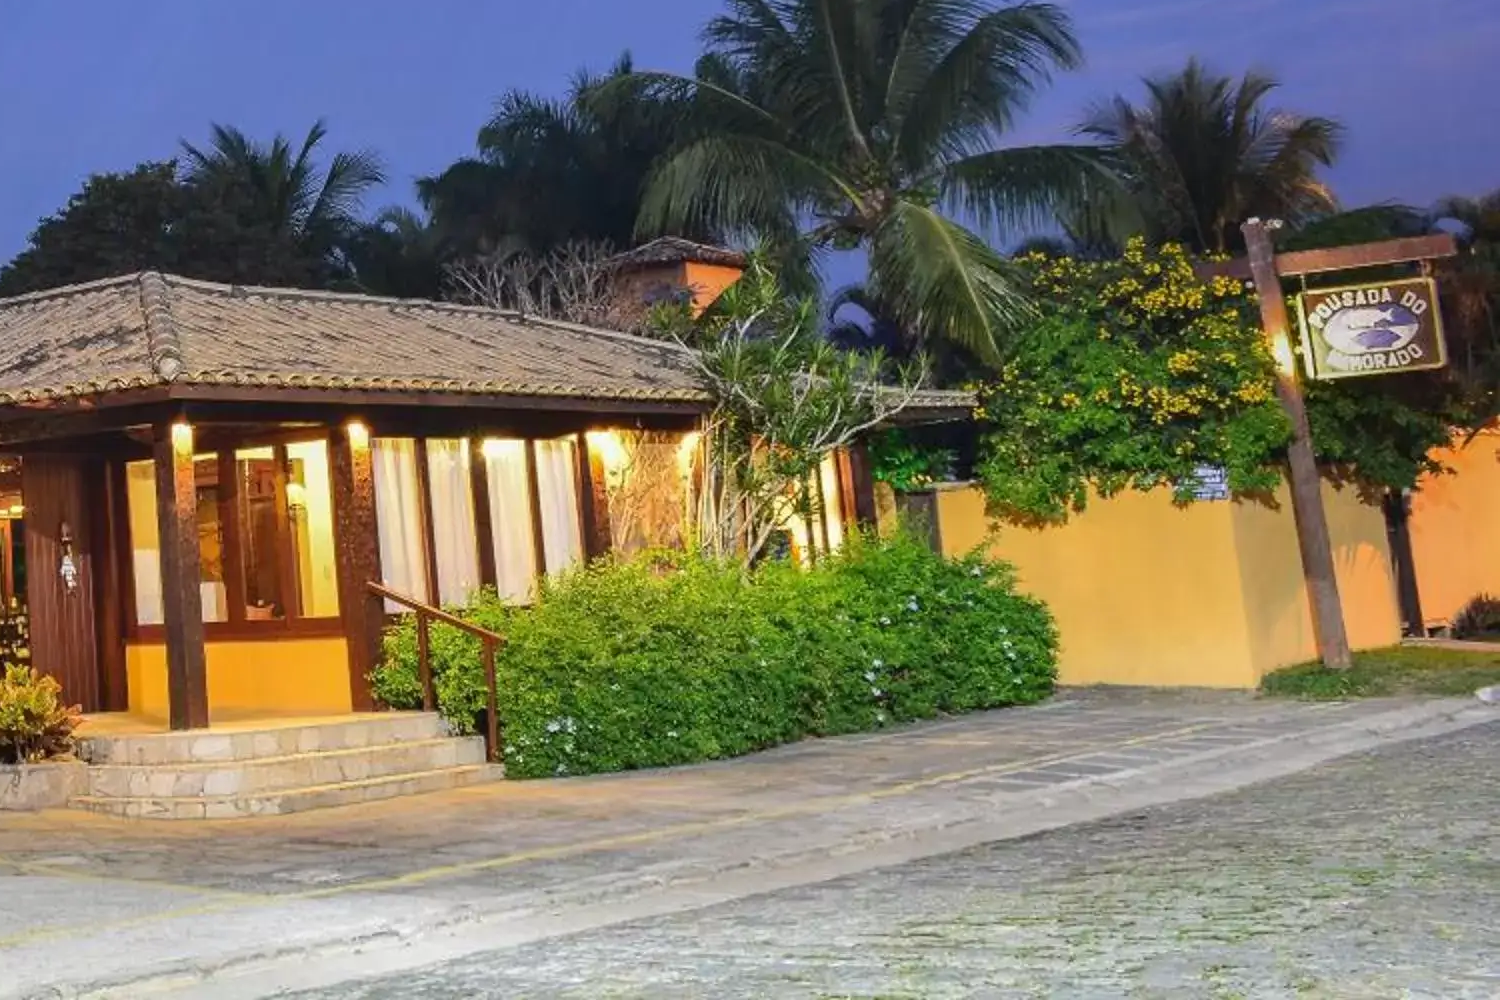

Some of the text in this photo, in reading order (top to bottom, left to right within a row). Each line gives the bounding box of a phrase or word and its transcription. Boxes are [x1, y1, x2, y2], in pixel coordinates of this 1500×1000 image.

[1308, 287, 1427, 329] POUSADA DO
[1326, 343, 1423, 371] MORADO
